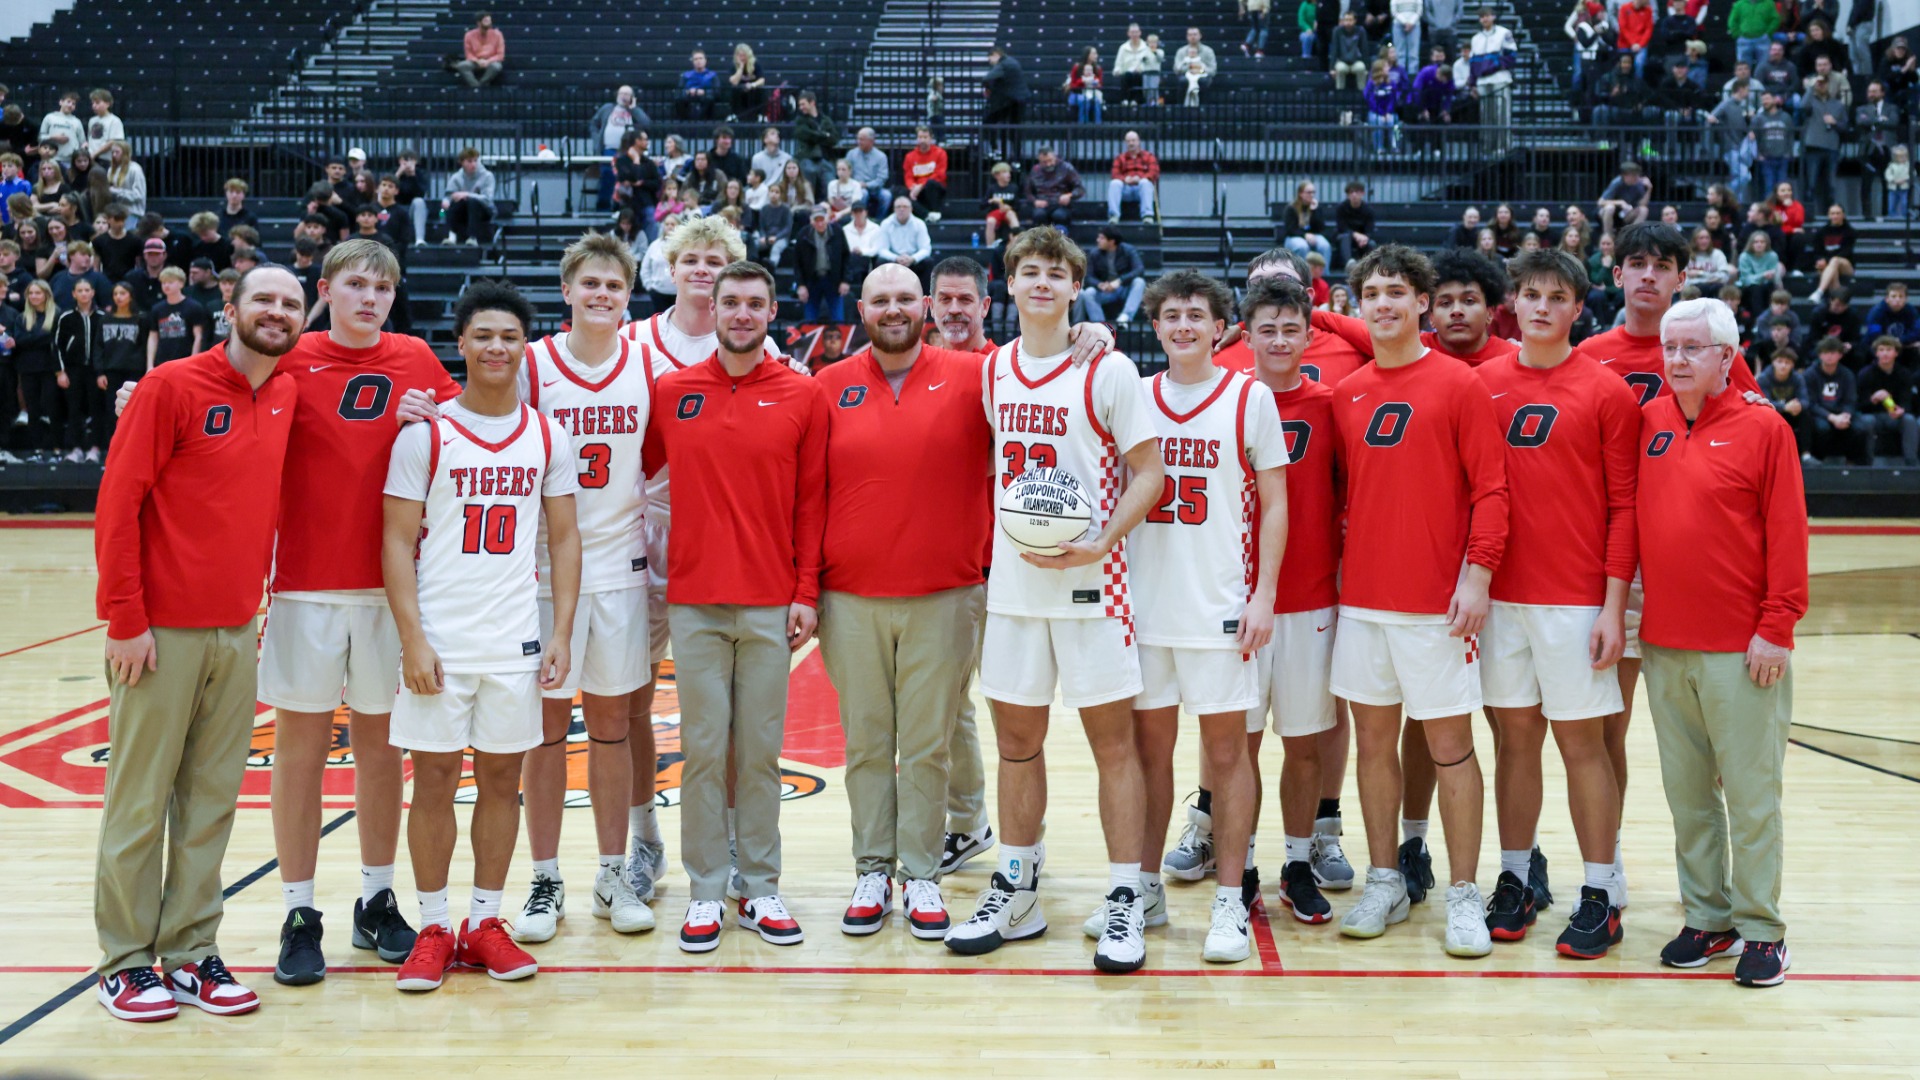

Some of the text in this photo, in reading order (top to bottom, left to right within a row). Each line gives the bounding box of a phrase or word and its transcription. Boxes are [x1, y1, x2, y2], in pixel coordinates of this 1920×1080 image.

[337, 373, 394, 421] O
[676, 392, 705, 421] O
[838, 384, 868, 408] O
[203, 403, 233, 437] O
[553, 405, 638, 436] TIGERS
[998, 402, 1069, 437] TIGERS
[1364, 401, 1414, 448] O
[1506, 403, 1560, 449] O
[1158, 437, 1221, 469] GERS
[1646, 430, 1676, 457] O
[449, 466, 538, 498] TIGERS
[578, 443, 612, 489] 3
[1146, 475, 1208, 525] 25
[462, 503, 517, 555] 10
